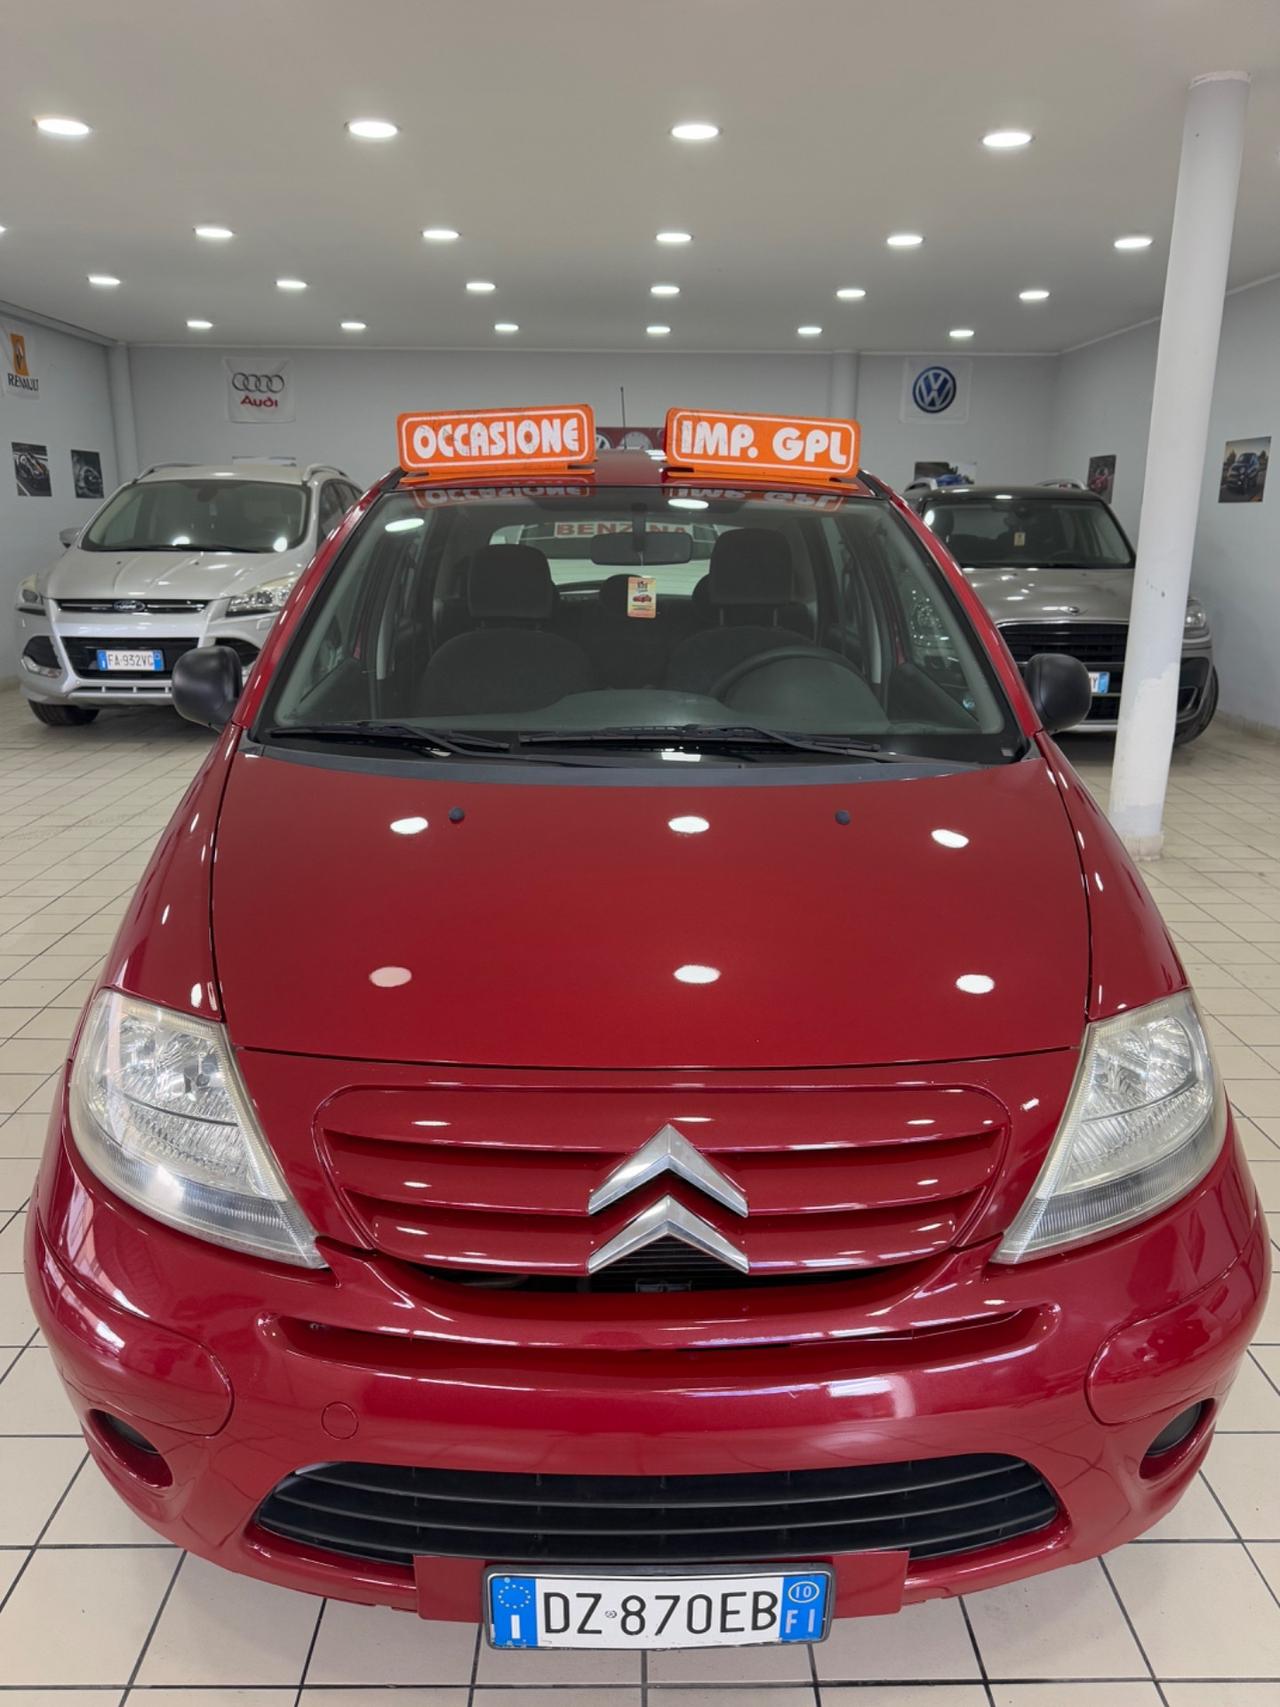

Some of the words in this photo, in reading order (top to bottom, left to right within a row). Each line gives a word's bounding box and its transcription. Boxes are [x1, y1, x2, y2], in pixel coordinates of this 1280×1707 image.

[240, 395, 279, 408] Audi
[413, 417, 580, 459] OCCASIONE
[681, 420, 759, 459] IMP.
[772, 427, 847, 465] GPL
[556, 522, 687, 536] BENZNA
